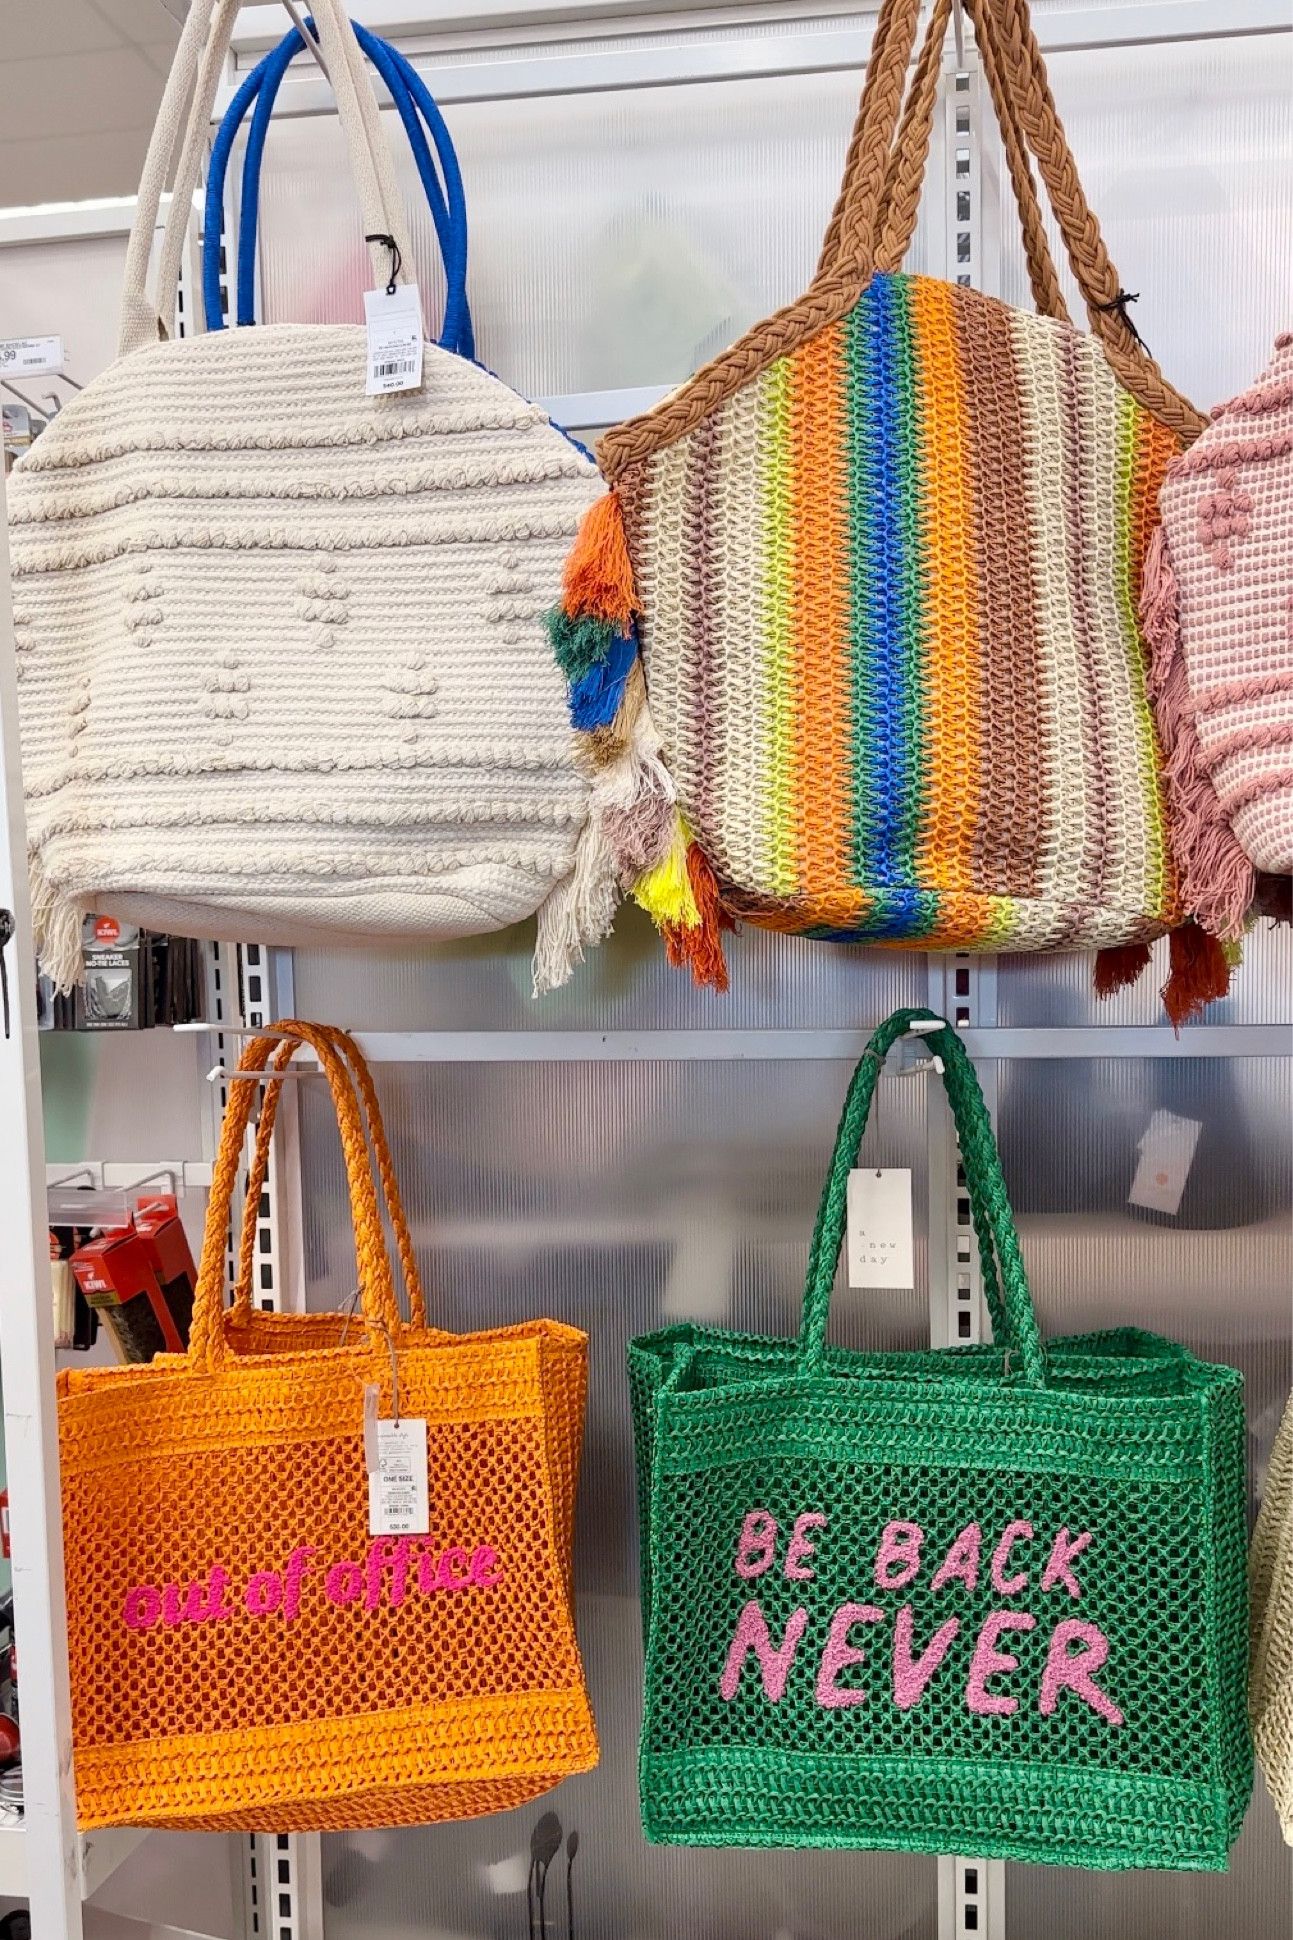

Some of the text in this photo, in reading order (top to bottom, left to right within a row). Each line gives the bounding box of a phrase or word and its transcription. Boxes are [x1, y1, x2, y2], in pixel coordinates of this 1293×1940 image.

[859, 1255, 888, 1265] day
[122, 1535, 502, 1629] out of office
[735, 1509, 1092, 1599] BE BACK
[719, 1600, 1125, 1726] NEVER
